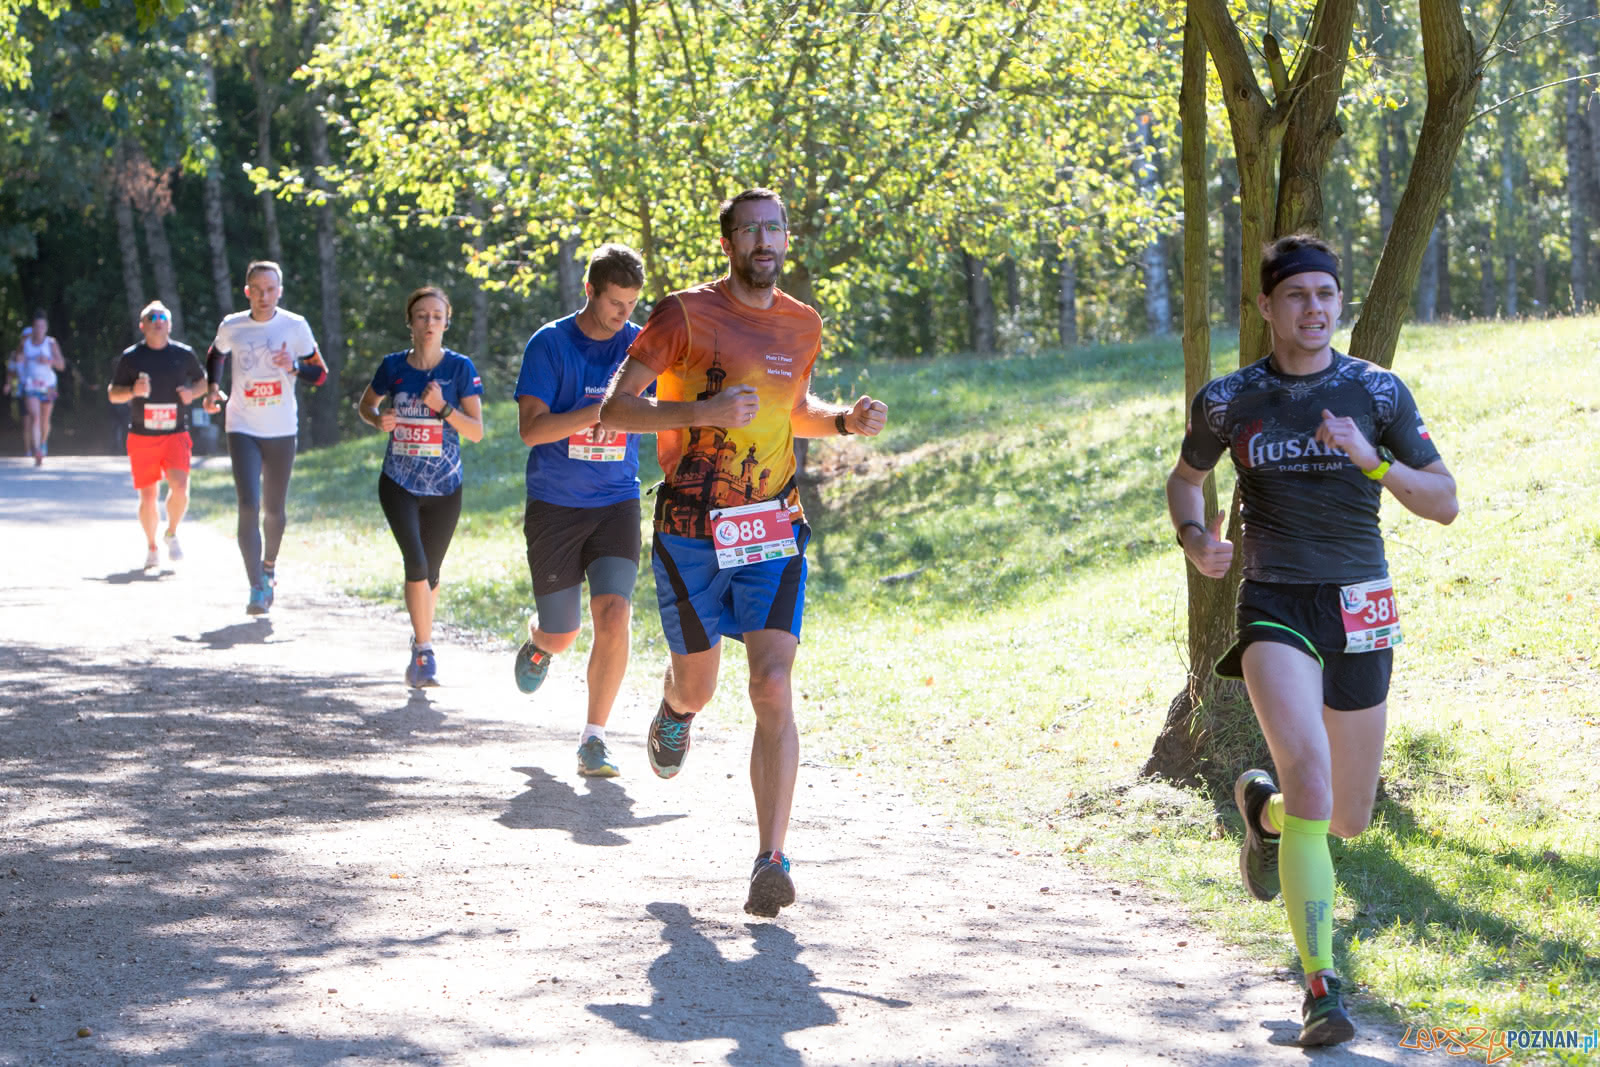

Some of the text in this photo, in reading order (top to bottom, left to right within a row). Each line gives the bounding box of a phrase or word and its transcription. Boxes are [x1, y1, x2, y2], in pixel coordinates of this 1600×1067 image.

[253, 384, 274, 397] 203
[400, 407, 430, 417] WORLD
[406, 427, 431, 442] 355
[1278, 462, 1343, 473] RACE TEAM
[739, 518, 767, 541] 88
[1363, 595, 1397, 624] 381
